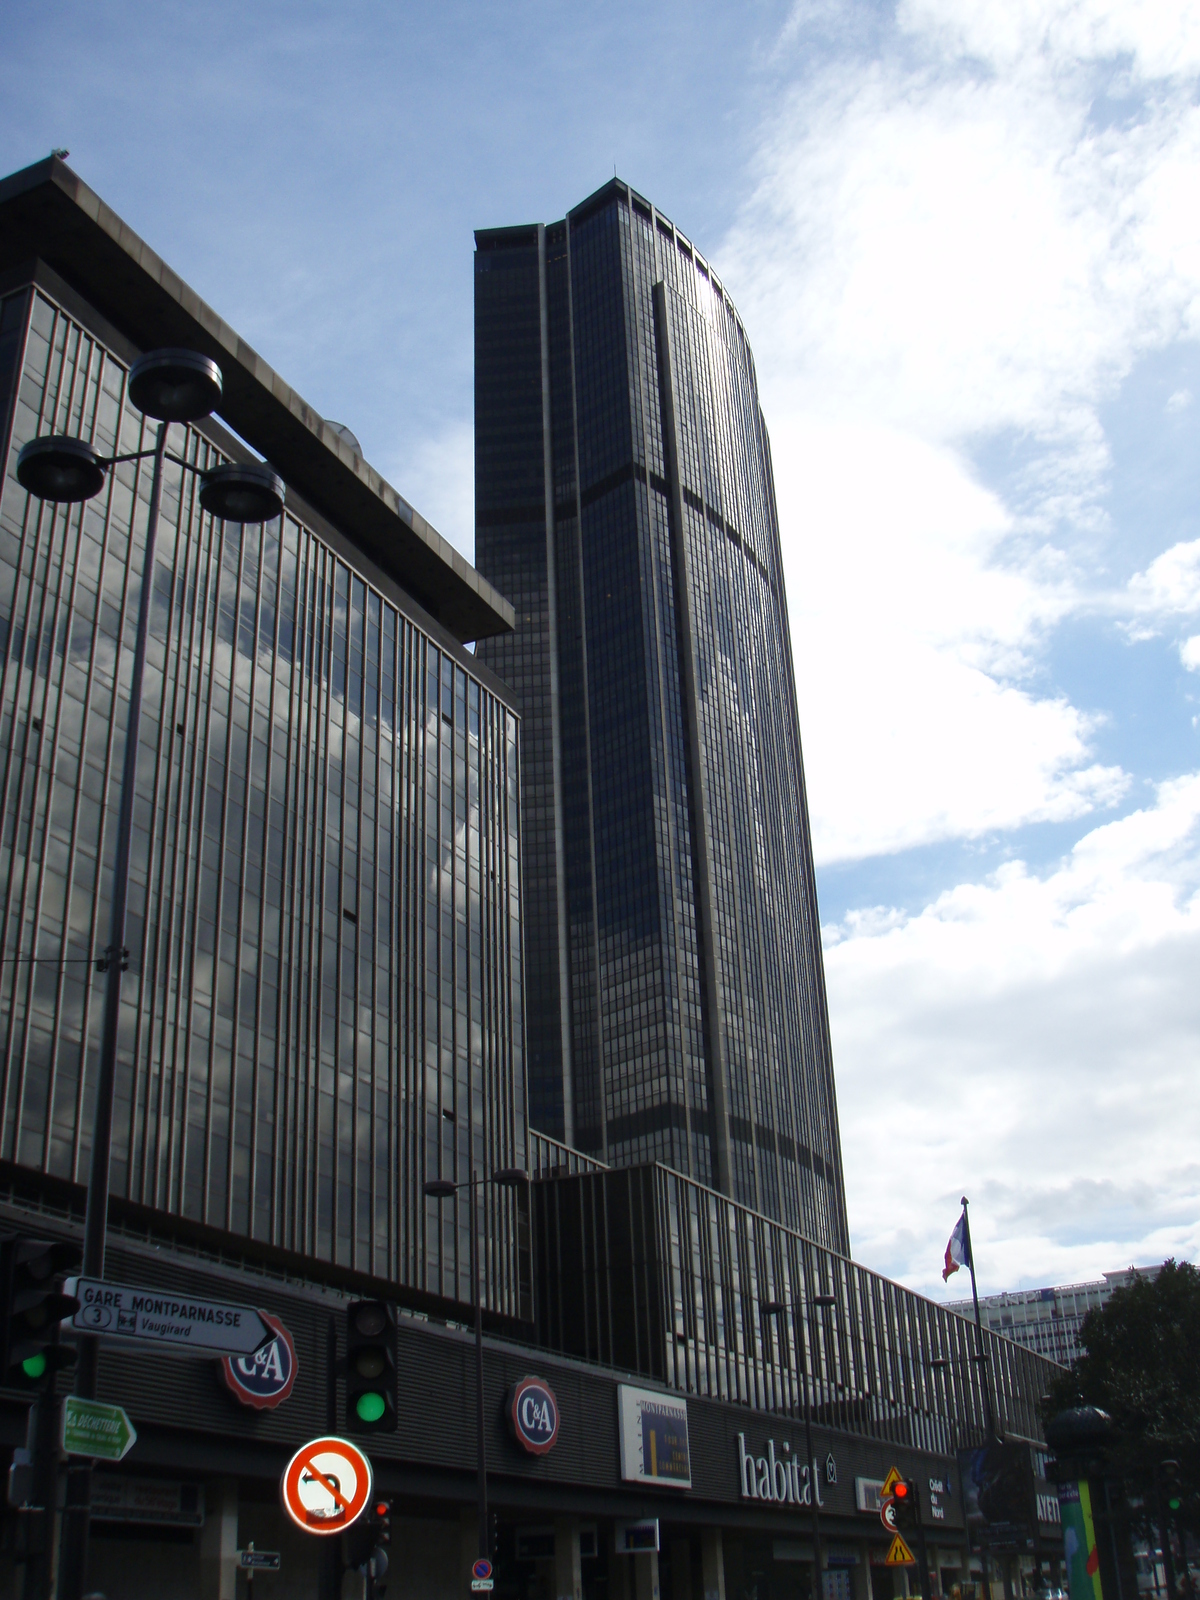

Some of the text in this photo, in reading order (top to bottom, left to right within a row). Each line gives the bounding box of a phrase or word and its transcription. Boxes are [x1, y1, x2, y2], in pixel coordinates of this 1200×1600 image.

[84, 1287, 241, 1328] GARE MONTPARNASSE
[985, 1292, 1037, 1309] CNP
[93, 1307, 192, 1337] 3 Vaugirard
[522, 1396, 553, 1432] C&A
[738, 1432, 824, 1507] habitat
[930, 1492, 938, 1505] du
[931, 1505, 944, 1519] Nord
